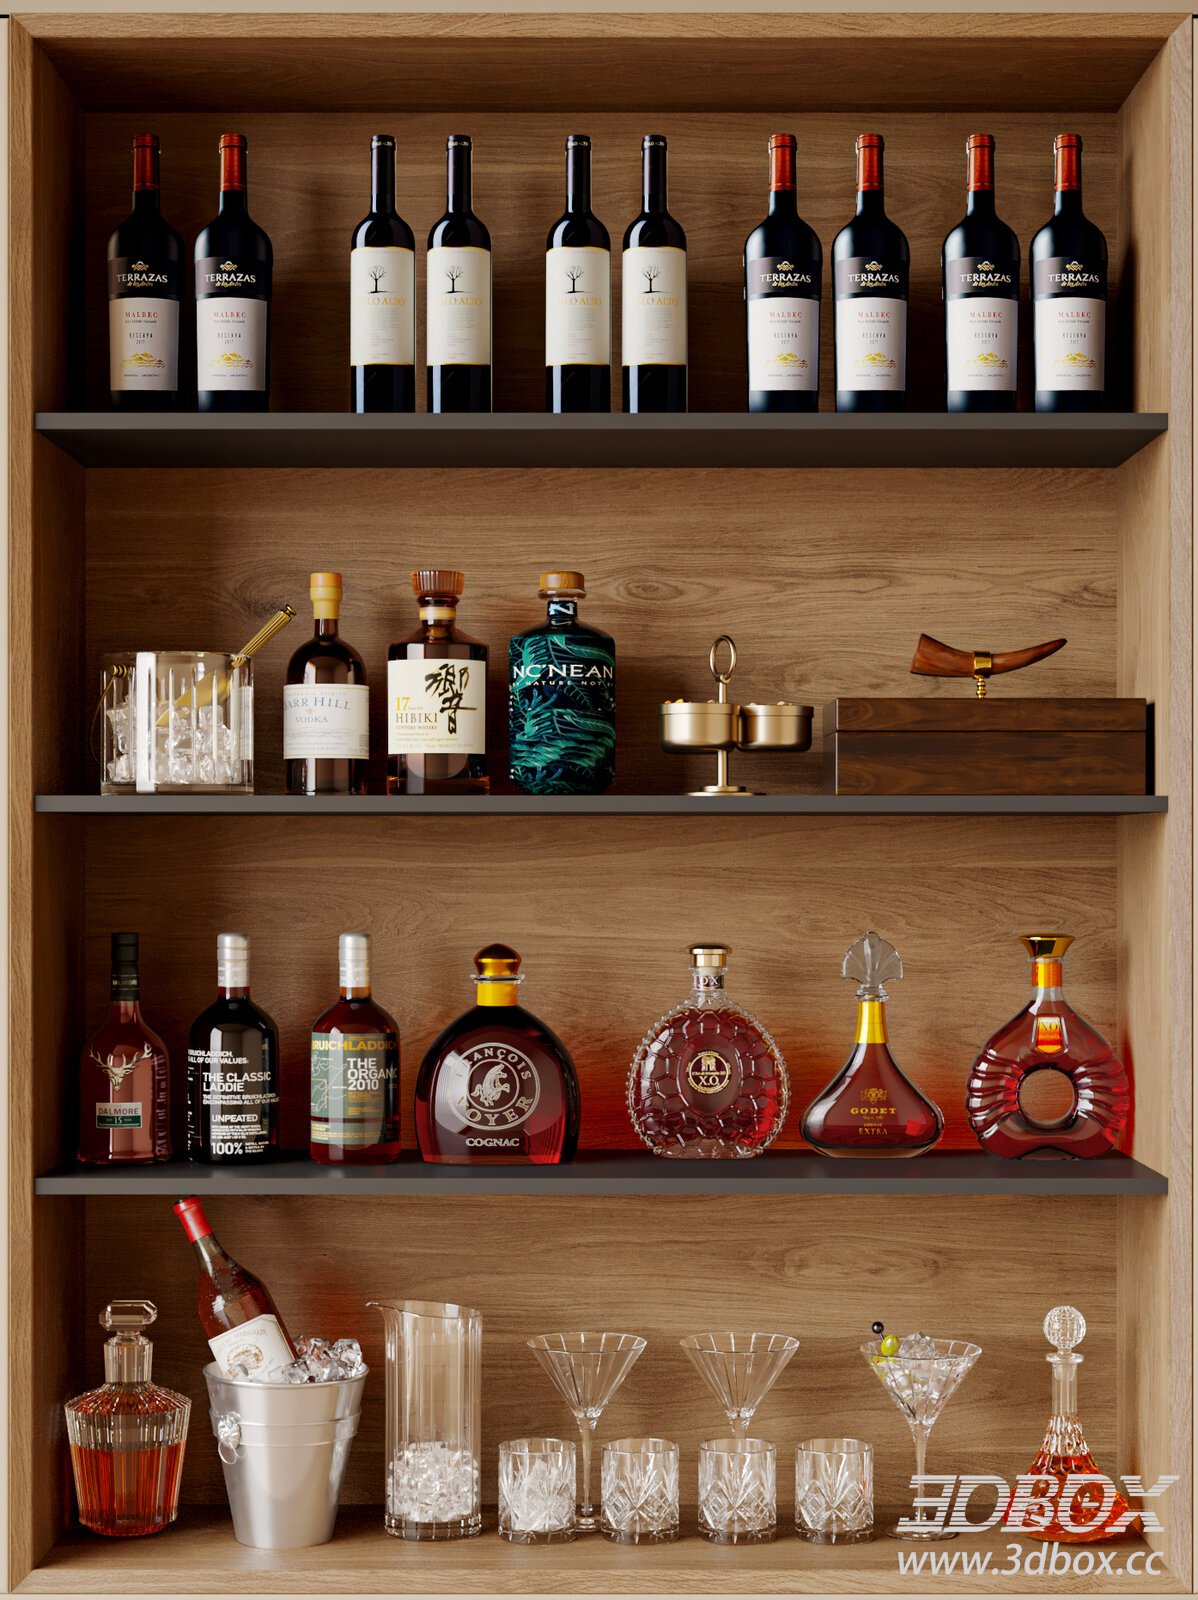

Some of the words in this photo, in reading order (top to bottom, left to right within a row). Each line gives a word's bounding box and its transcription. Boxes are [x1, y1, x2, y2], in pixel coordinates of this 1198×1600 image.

[116, 272, 168, 283] TERRAZAS
[204, 272, 256, 283] TERRAZAS
[760, 272, 812, 283] TERRAZAS
[848, 272, 900, 283] TERRAZAS
[960, 272, 1012, 283] TERRAZAS
[1048, 272, 1100, 283] TERRAZAS
[513, 664, 613, 678] NC'NEAN
[314, 697, 351, 710] HILL
[396, 697, 410, 711] 17
[295, 715, 328, 723] VODKA
[396, 713, 438, 723] HIBIKI
[1040, 1022, 1058, 1030] XO
[347, 1058, 376, 1068] THE
[461, 1048, 532, 1079] RANÇOIS
[202, 1072, 224, 1082] THE
[226, 1072, 271, 1082] CLASSIC
[203, 1082, 244, 1092] LADDIE
[348, 1080, 379, 1090] 2010
[114, 1116, 122, 1124] 15
[211, 1114, 258, 1122] UNPEATED
[465, 1138, 520, 1147] COGNAC
[211, 1142, 243, 1155] 100%
